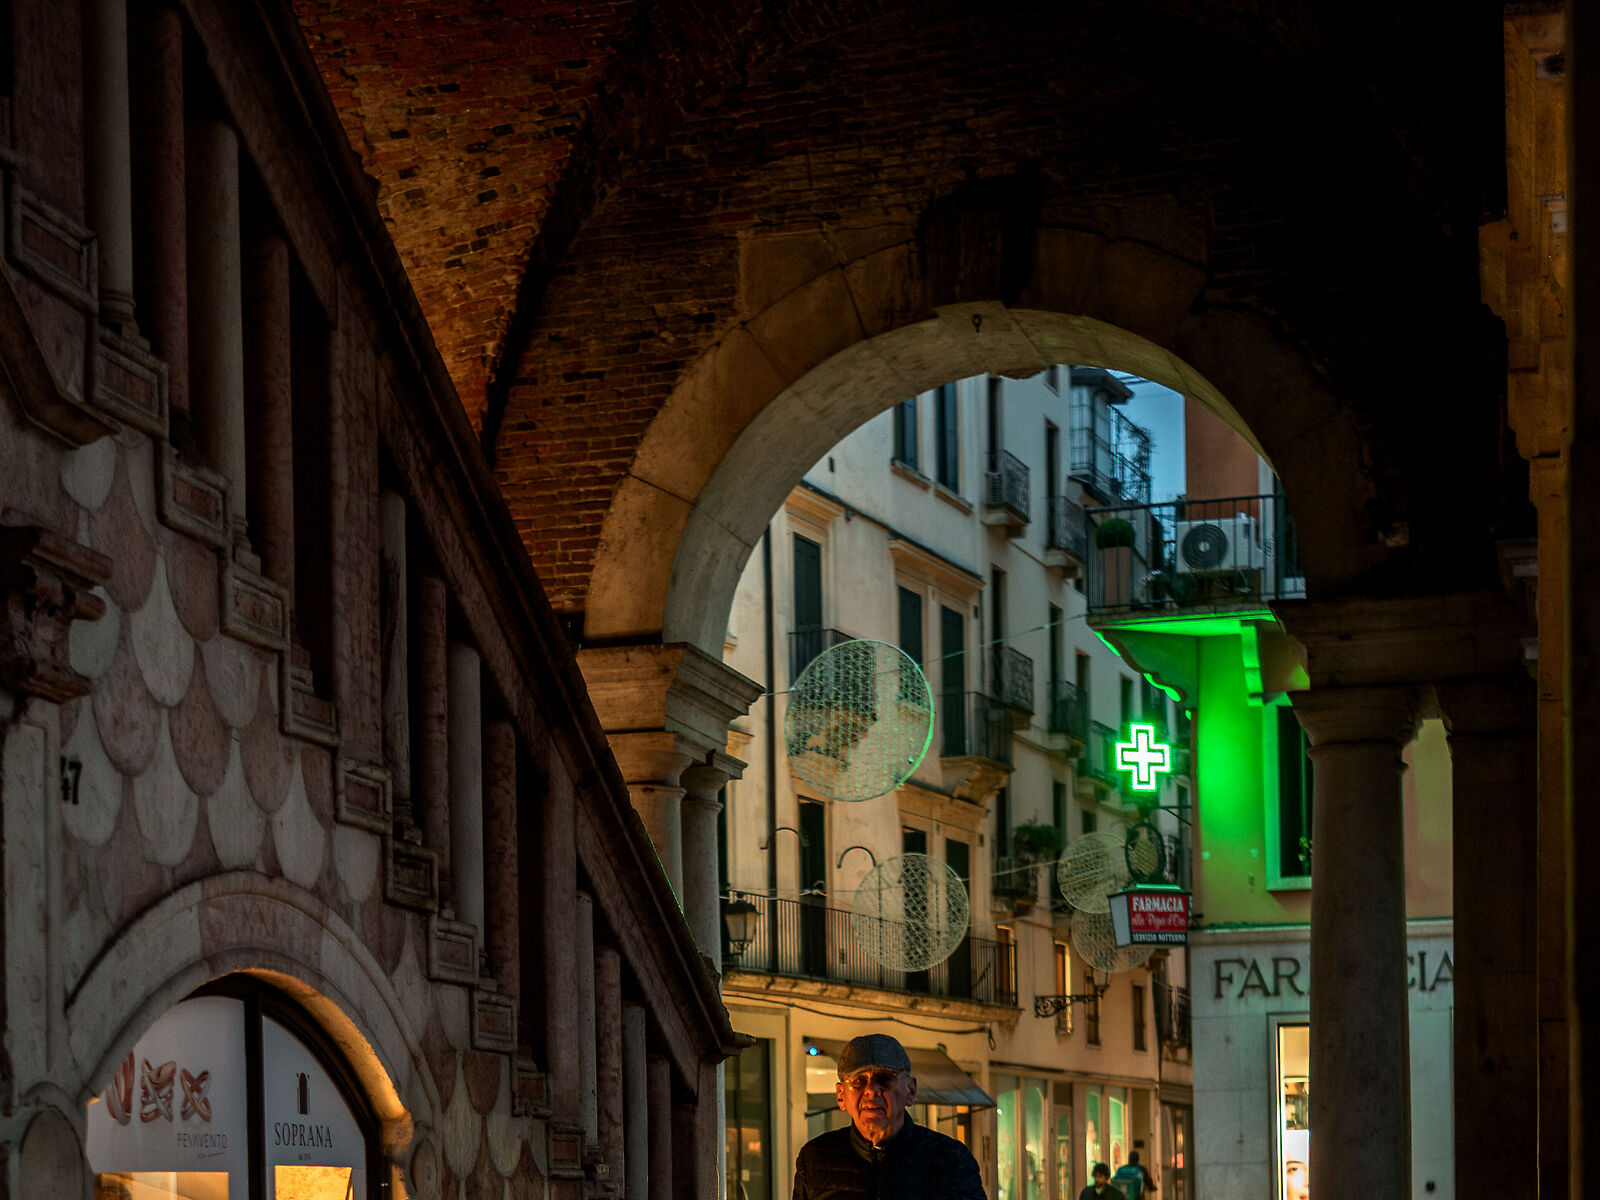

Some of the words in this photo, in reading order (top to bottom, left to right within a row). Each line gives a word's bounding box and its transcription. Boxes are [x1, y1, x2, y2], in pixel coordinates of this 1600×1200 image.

[1132, 896, 1185, 912] FARMACIA
[1133, 933, 1156, 942] SERVIZIO
[1158, 933, 1185, 942] NOTTURNO
[274, 1122, 333, 1148] SOPRANA
